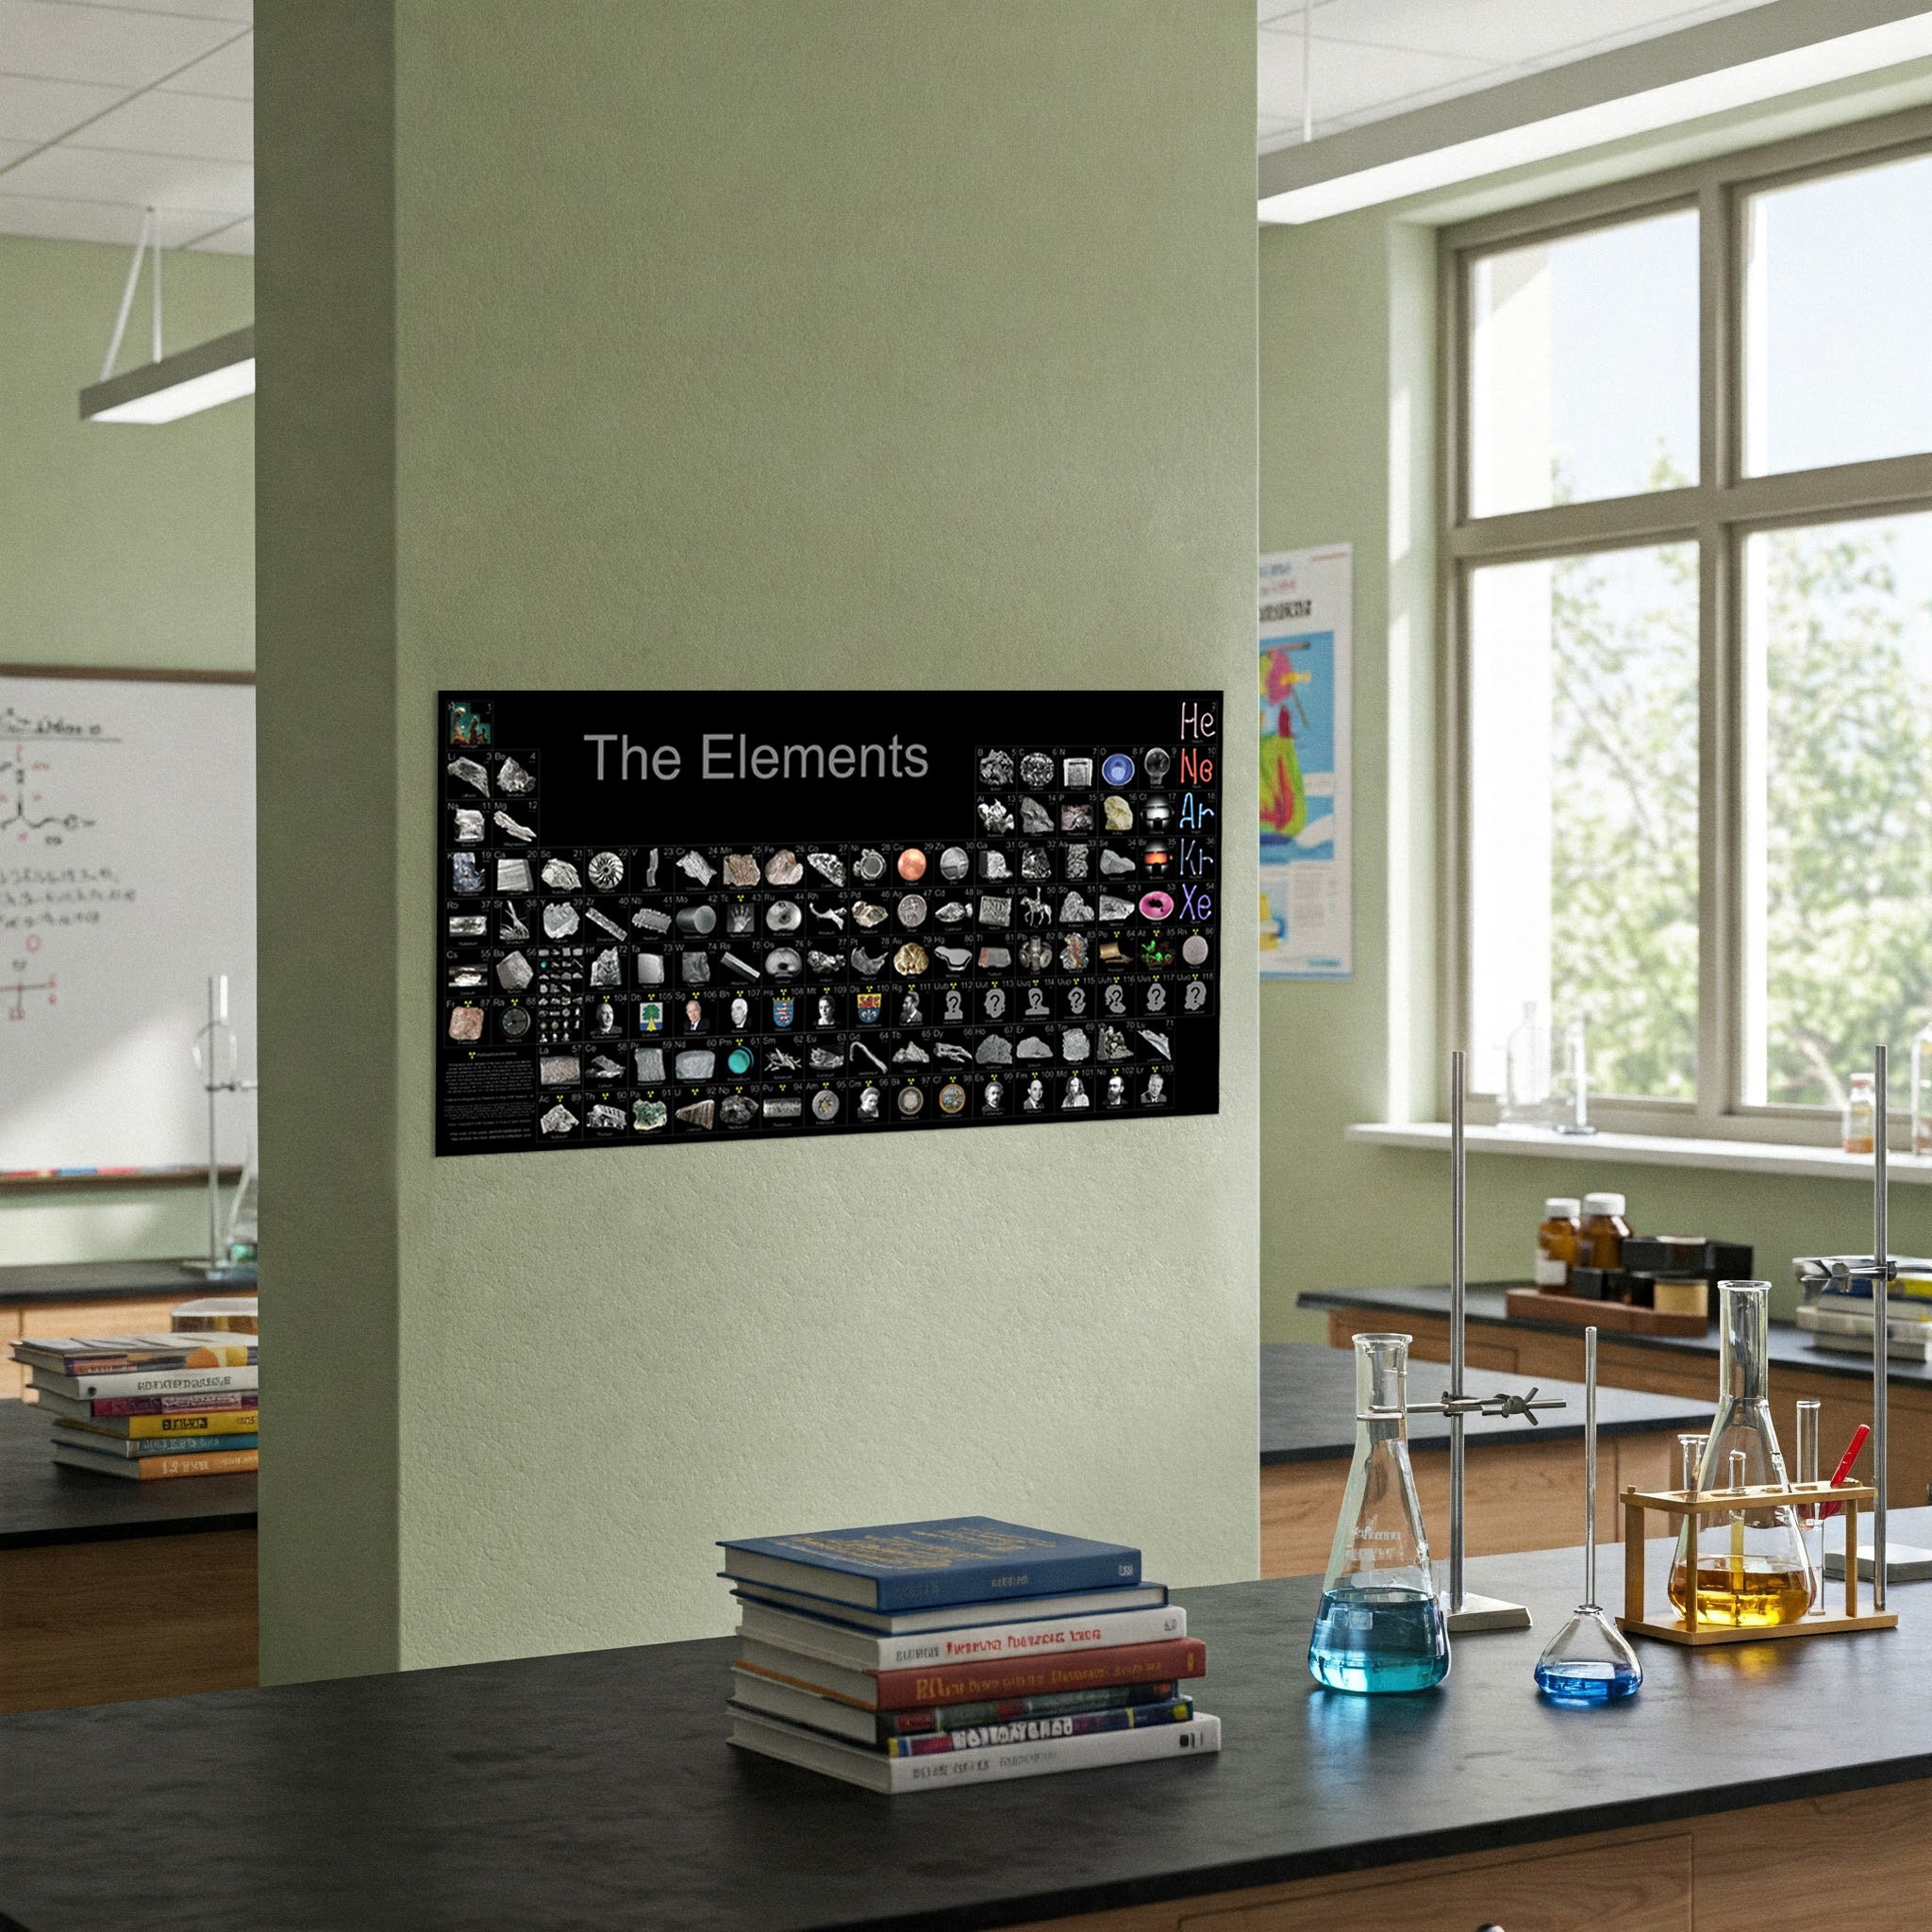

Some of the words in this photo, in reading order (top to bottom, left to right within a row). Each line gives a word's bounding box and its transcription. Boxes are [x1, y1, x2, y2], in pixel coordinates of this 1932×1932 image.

[1181, 702, 1216, 740] He
[584, 733, 681, 781] The
[702, 733, 929, 780] Elements
[1181, 748, 1213, 785] Ne
[1179, 792, 1214, 829] Ar
[664, 847, 674, 856] 23
[481, 900, 491, 908] 37
[708, 894, 718, 903] 42
[1179, 883, 1211, 921] Xe
[572, 1044, 581, 1053] 57
